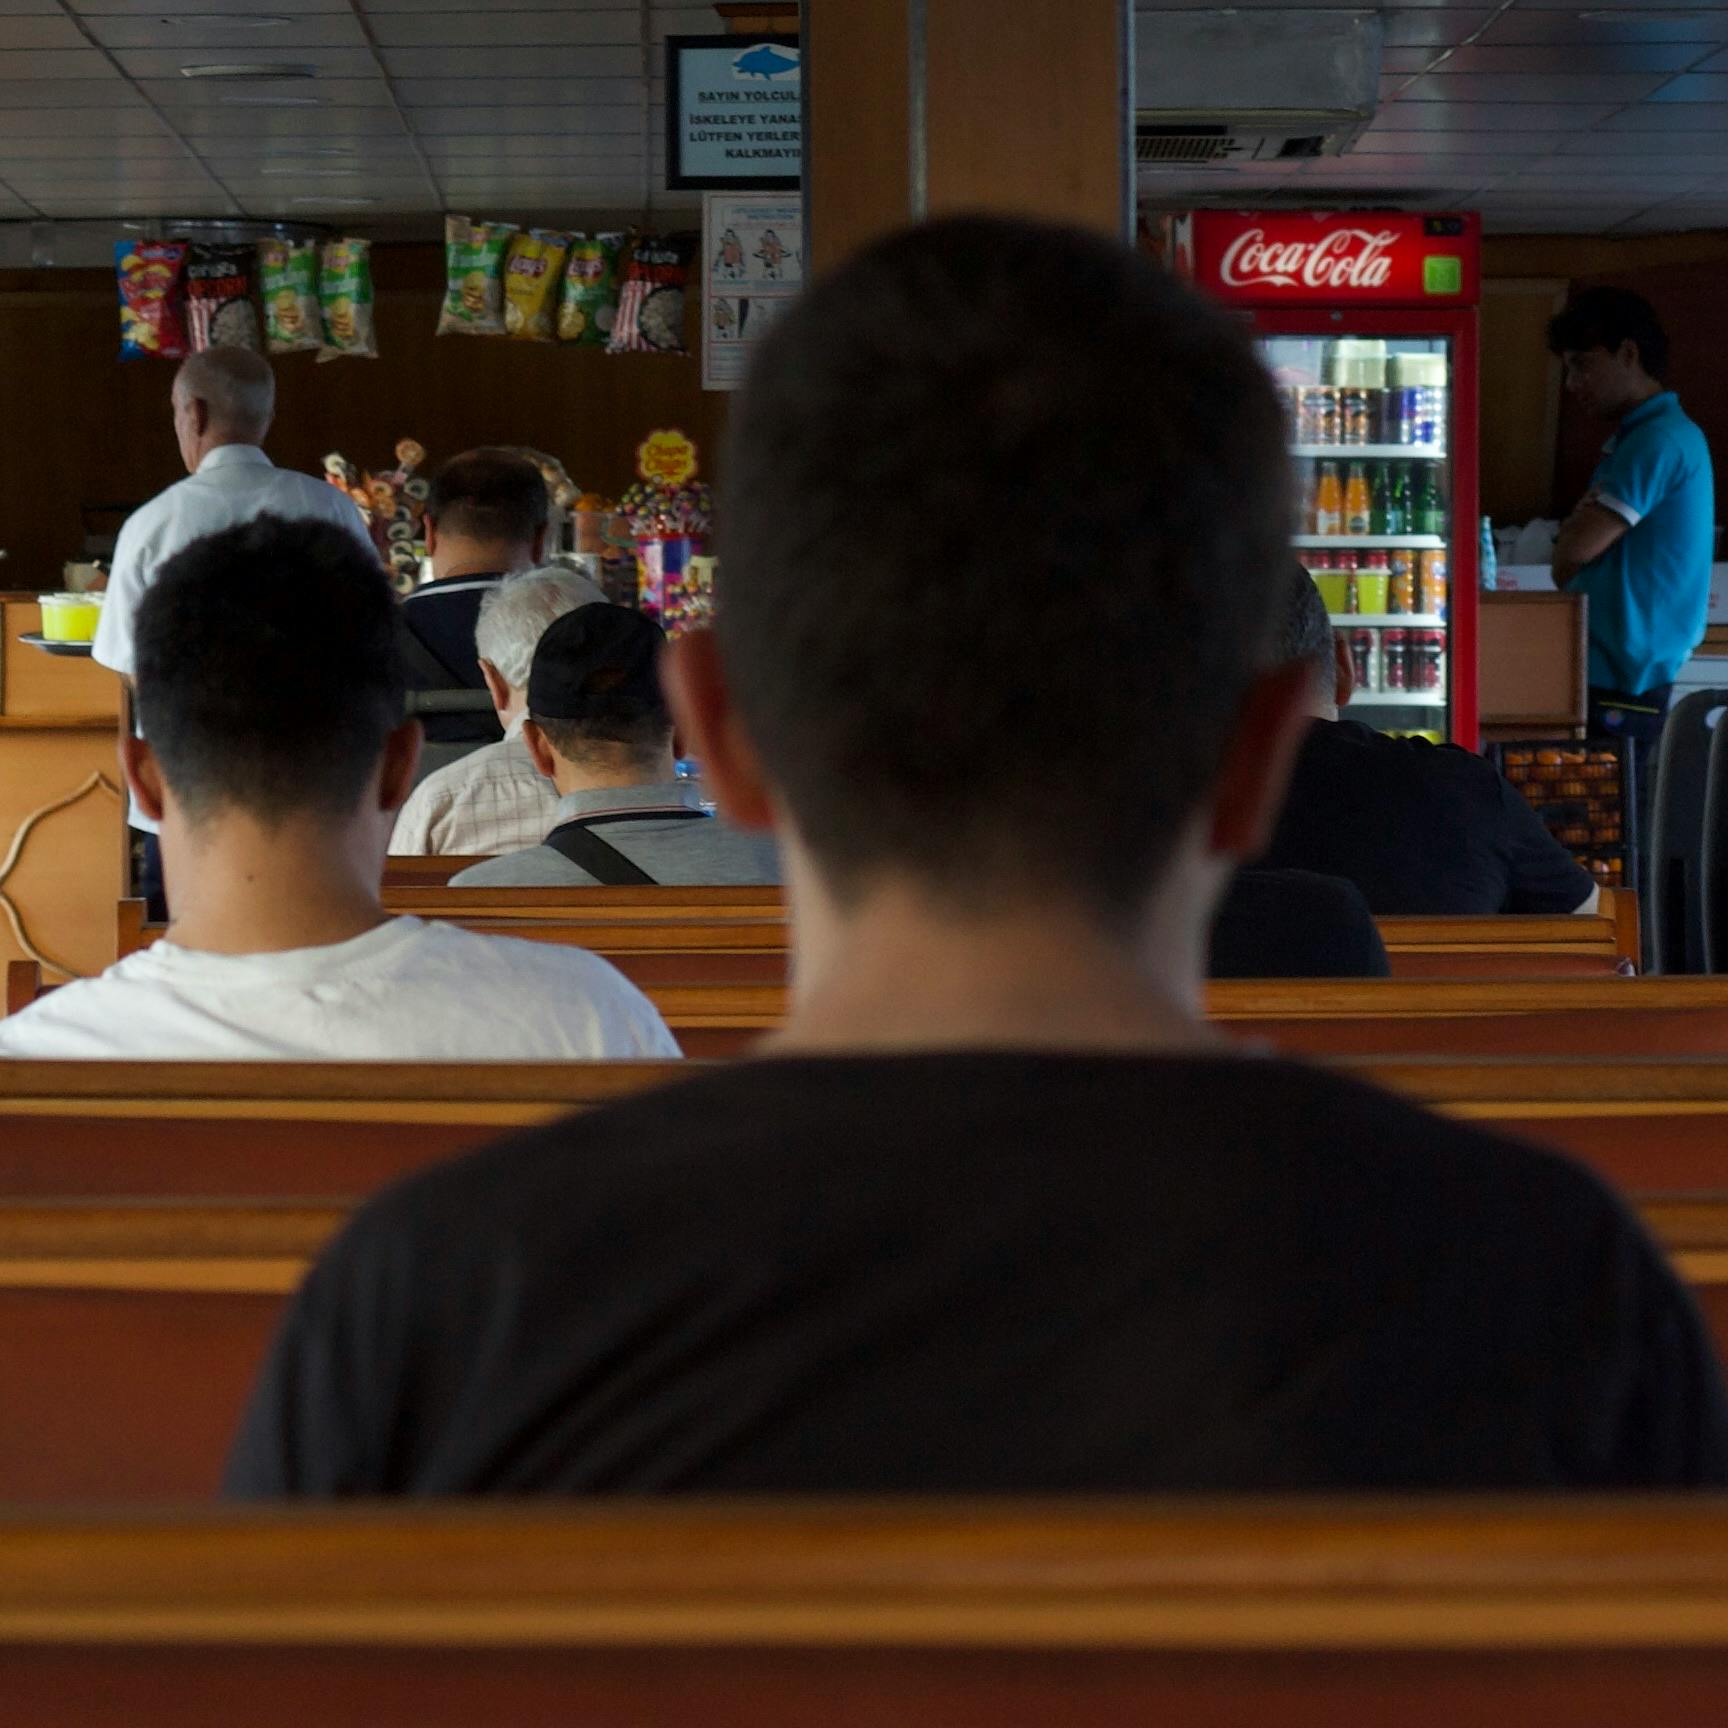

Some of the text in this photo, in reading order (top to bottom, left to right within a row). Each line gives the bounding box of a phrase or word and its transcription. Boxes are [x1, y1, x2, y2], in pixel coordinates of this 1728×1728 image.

[698, 90, 801, 102] SAYIN YOLCUL
[689, 112, 756, 125] İSKELEYE
[689, 129, 743, 142] LÜTFEN
[1219, 227, 1402, 288] Coca-Cola
